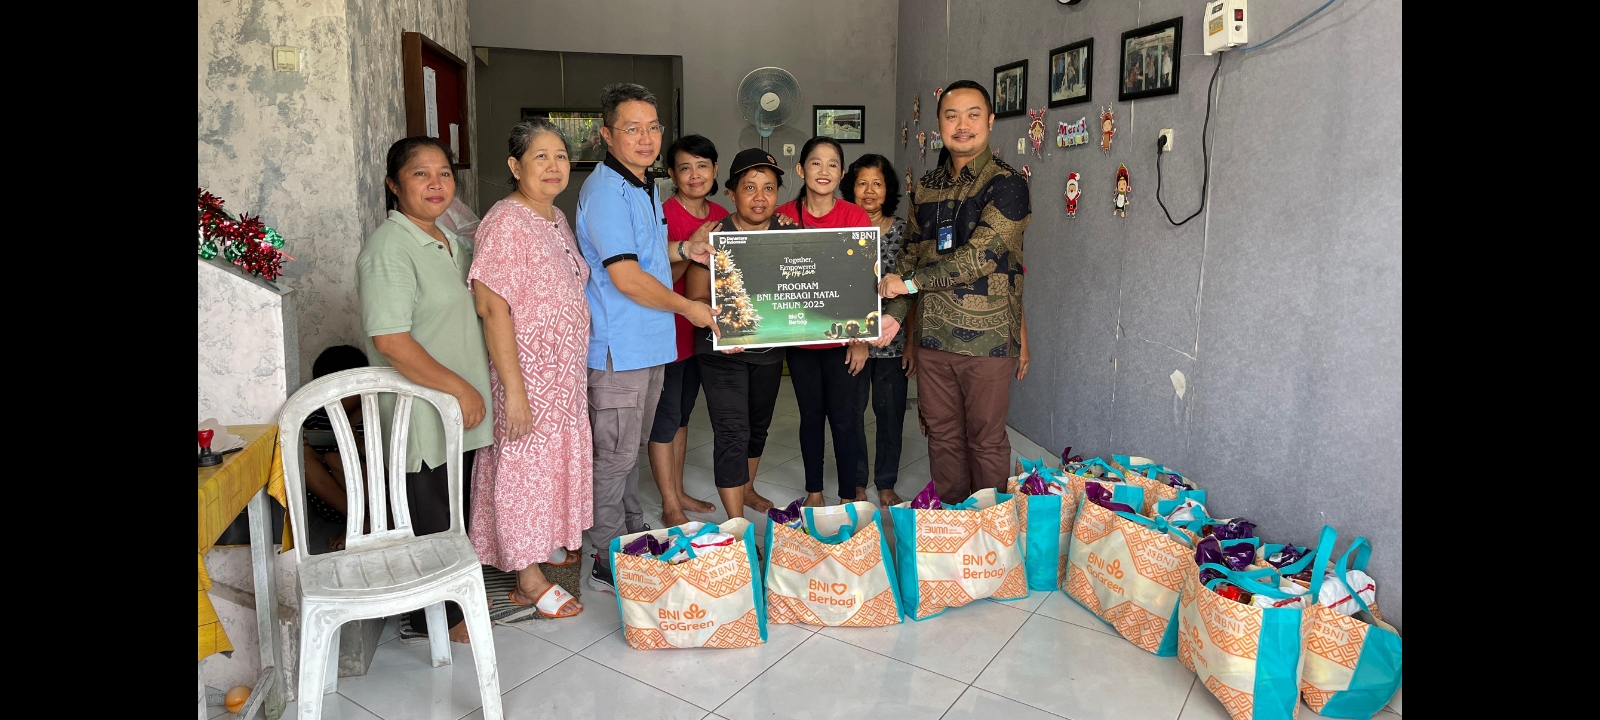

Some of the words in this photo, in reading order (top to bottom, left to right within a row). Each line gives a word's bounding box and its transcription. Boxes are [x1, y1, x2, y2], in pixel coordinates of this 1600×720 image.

[1059, 119, 1085, 135] Merry
[780, 263, 816, 271] Empowered
[777, 282, 819, 291] PROGRAM
[756, 293, 772, 302] BNI
[774, 291, 811, 300] BERBAGI
[813, 290, 840, 299] NATAL
[772, 302, 801, 310] TAHUN
[803, 300, 825, 309] 2025
[962, 554, 983, 566] BNI
[1087, 552, 1105, 570] BNI
[1157, 553, 1175, 567] BNI
[718, 563, 736, 577] BNI
[962, 564, 1006, 579] Berbagi
[808, 578, 829, 593] BNI
[1087, 564, 1125, 596] GoGreen
[808, 591, 856, 609] Berbagi
[658, 607, 680, 621] BNI
[659, 620, 715, 631] GoGreen
[1221, 617, 1240, 633] BNI
[1322, 625, 1345, 641] BNI
